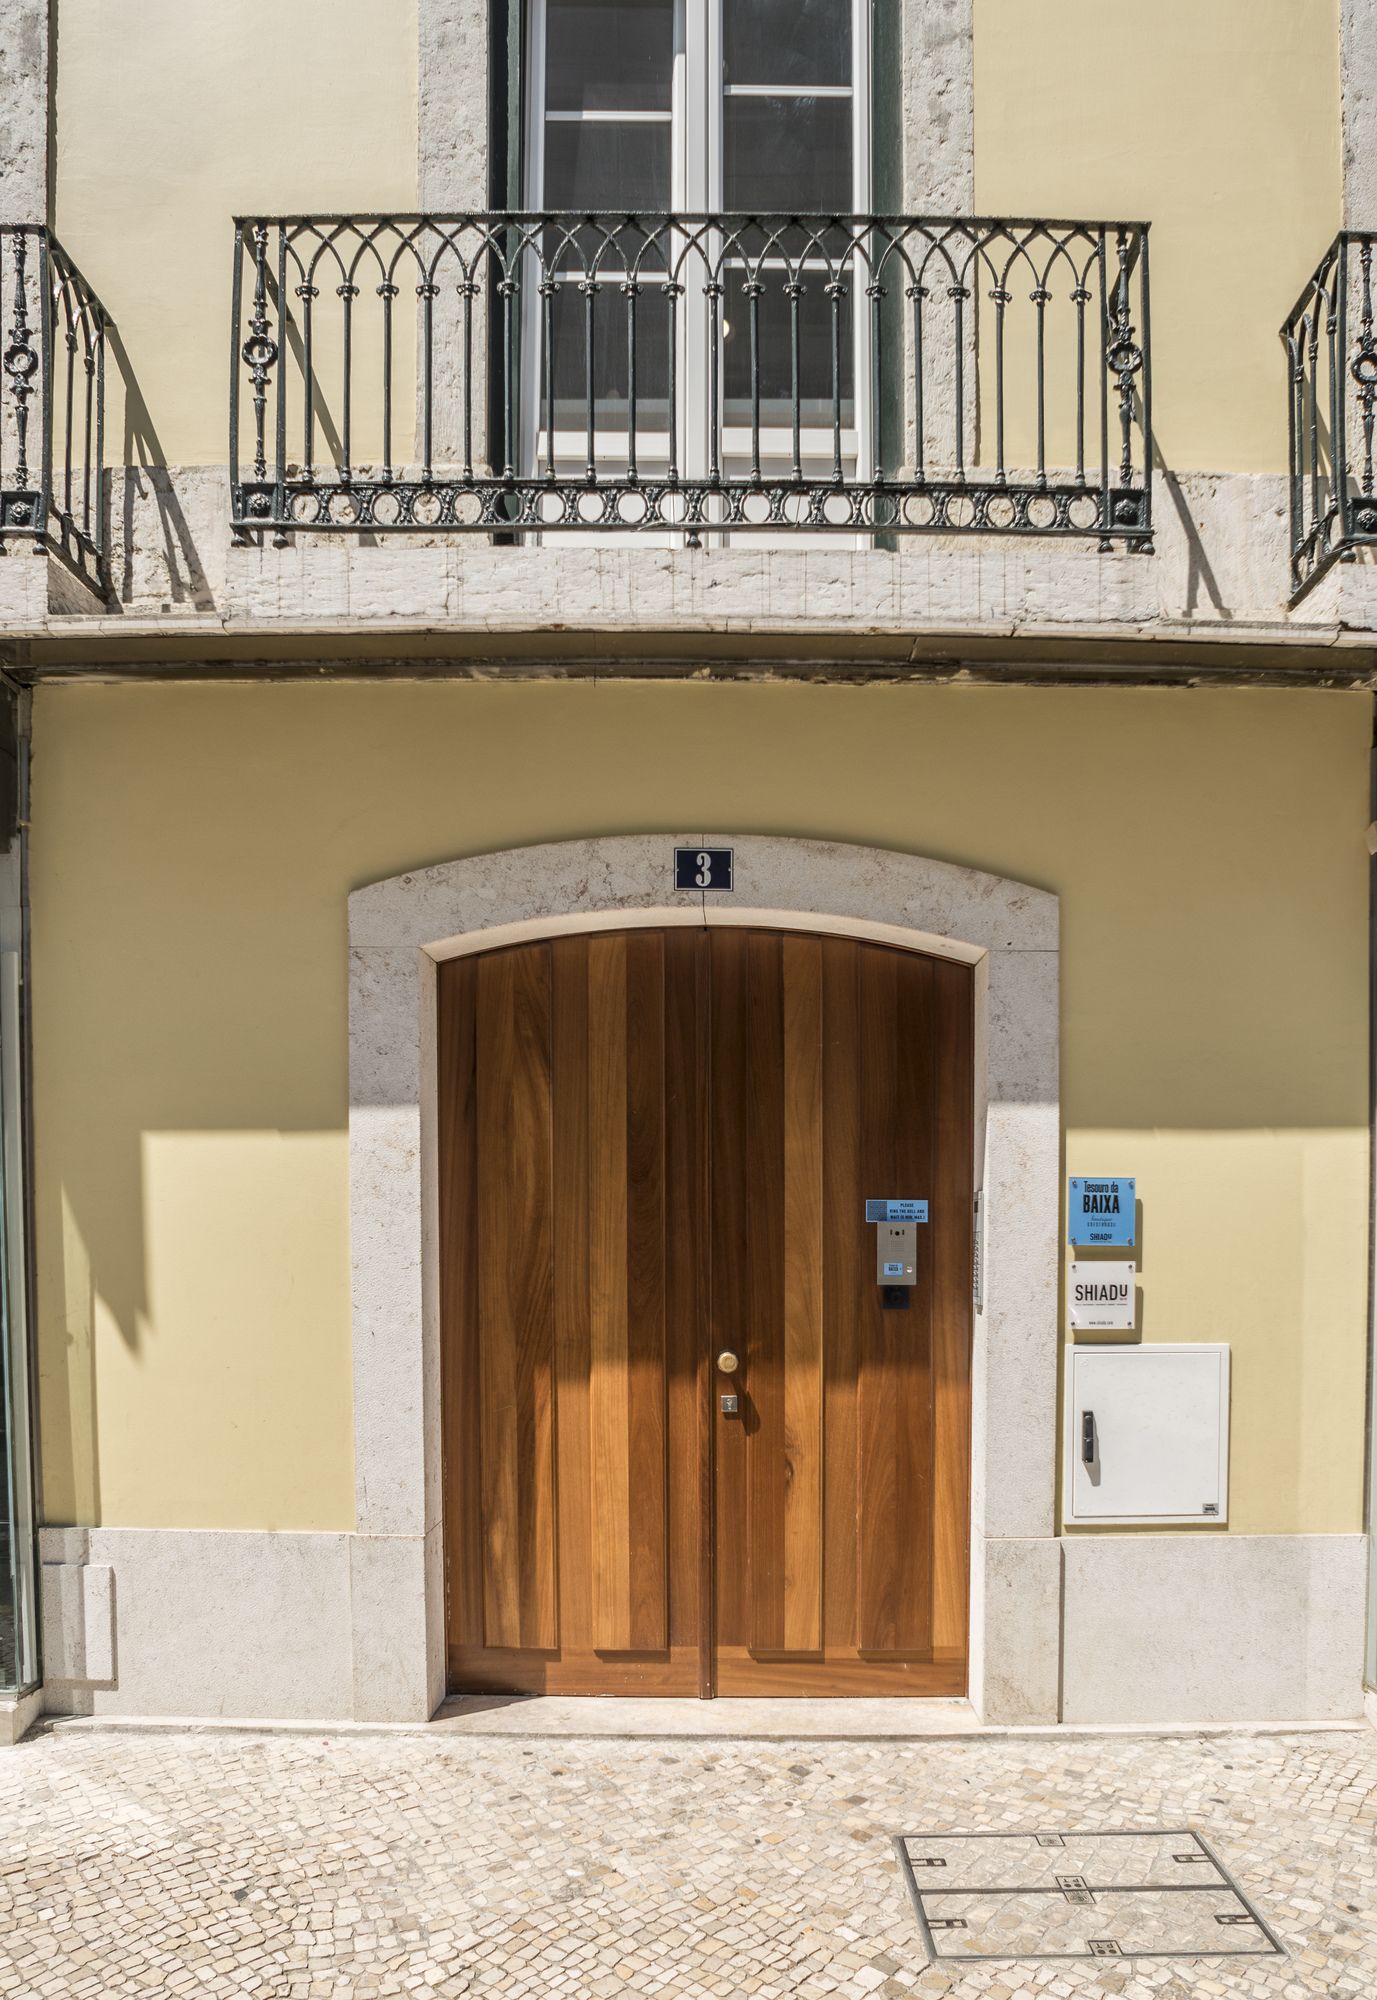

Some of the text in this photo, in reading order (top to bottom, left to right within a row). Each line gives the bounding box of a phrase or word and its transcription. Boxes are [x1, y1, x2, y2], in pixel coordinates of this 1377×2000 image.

[695, 852, 712, 887] 3
[1083, 1181, 1119, 1193] Tesouro da
[1083, 1194, 1120, 1213] BAIXA
[1089, 1233, 1112, 1241] SHIADU
[1075, 1284, 1128, 1301] SHIADU
